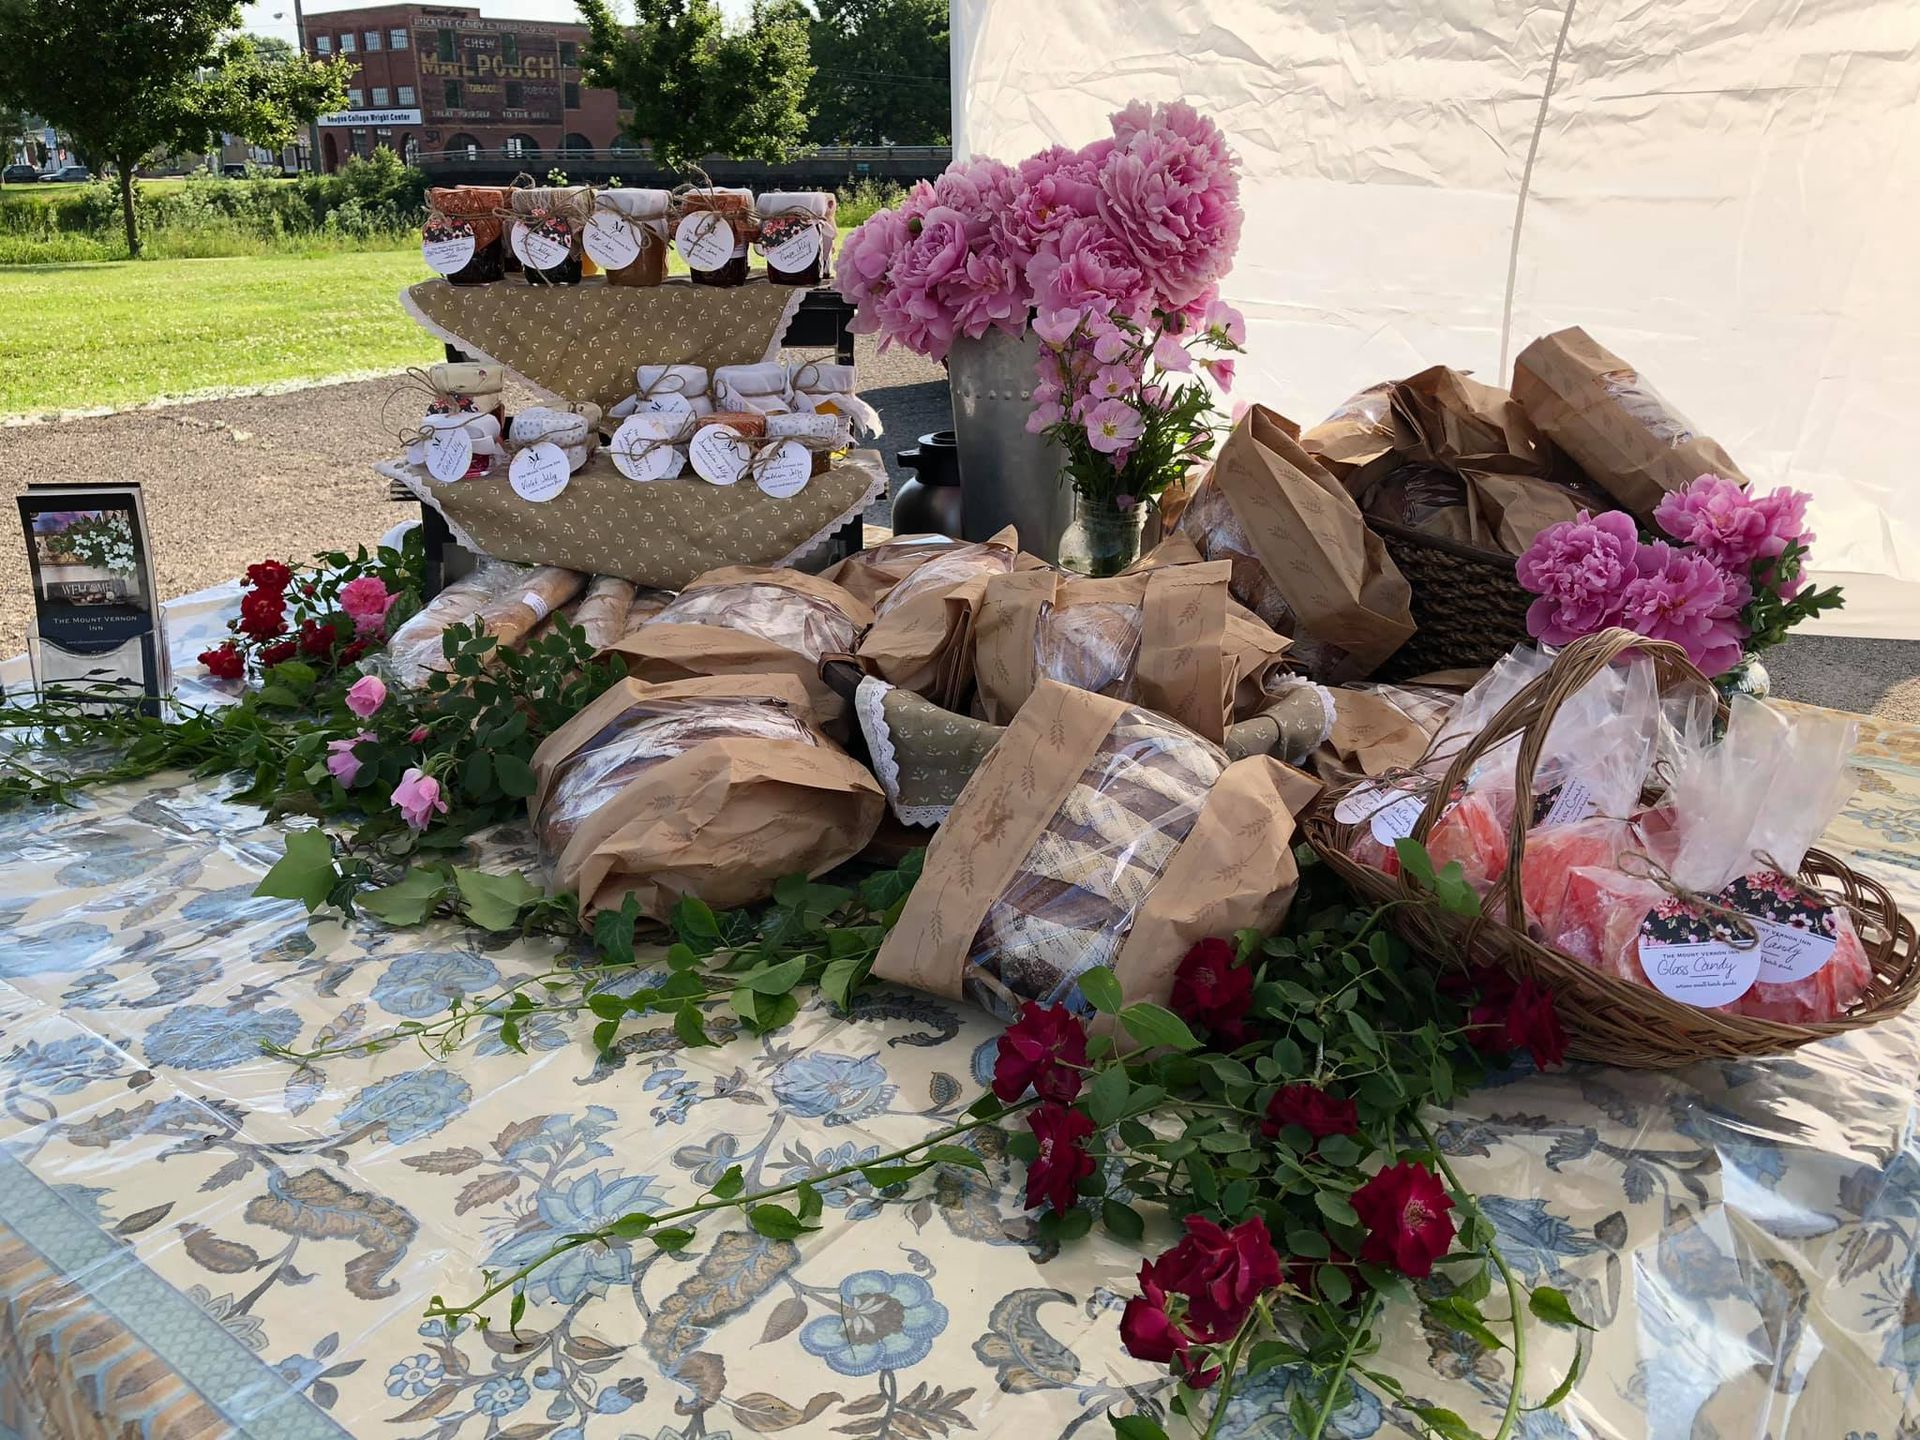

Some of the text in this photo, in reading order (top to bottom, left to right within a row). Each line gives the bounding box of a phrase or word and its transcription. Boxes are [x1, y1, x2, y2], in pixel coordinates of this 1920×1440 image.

[463, 37, 496, 49] CHEW
[347, 114, 370, 123] College
[370, 113, 390, 124] Wright
[390, 113, 411, 122] Center
[62, 582, 112, 595] WELCOME
[72, 616, 102, 624] MOUNT
[1771, 929, 1798, 942] VERNON
[1799, 938, 1812, 946] INN
[1763, 934, 1803, 964] Candy
[1657, 956, 1737, 979] Glass Candy
